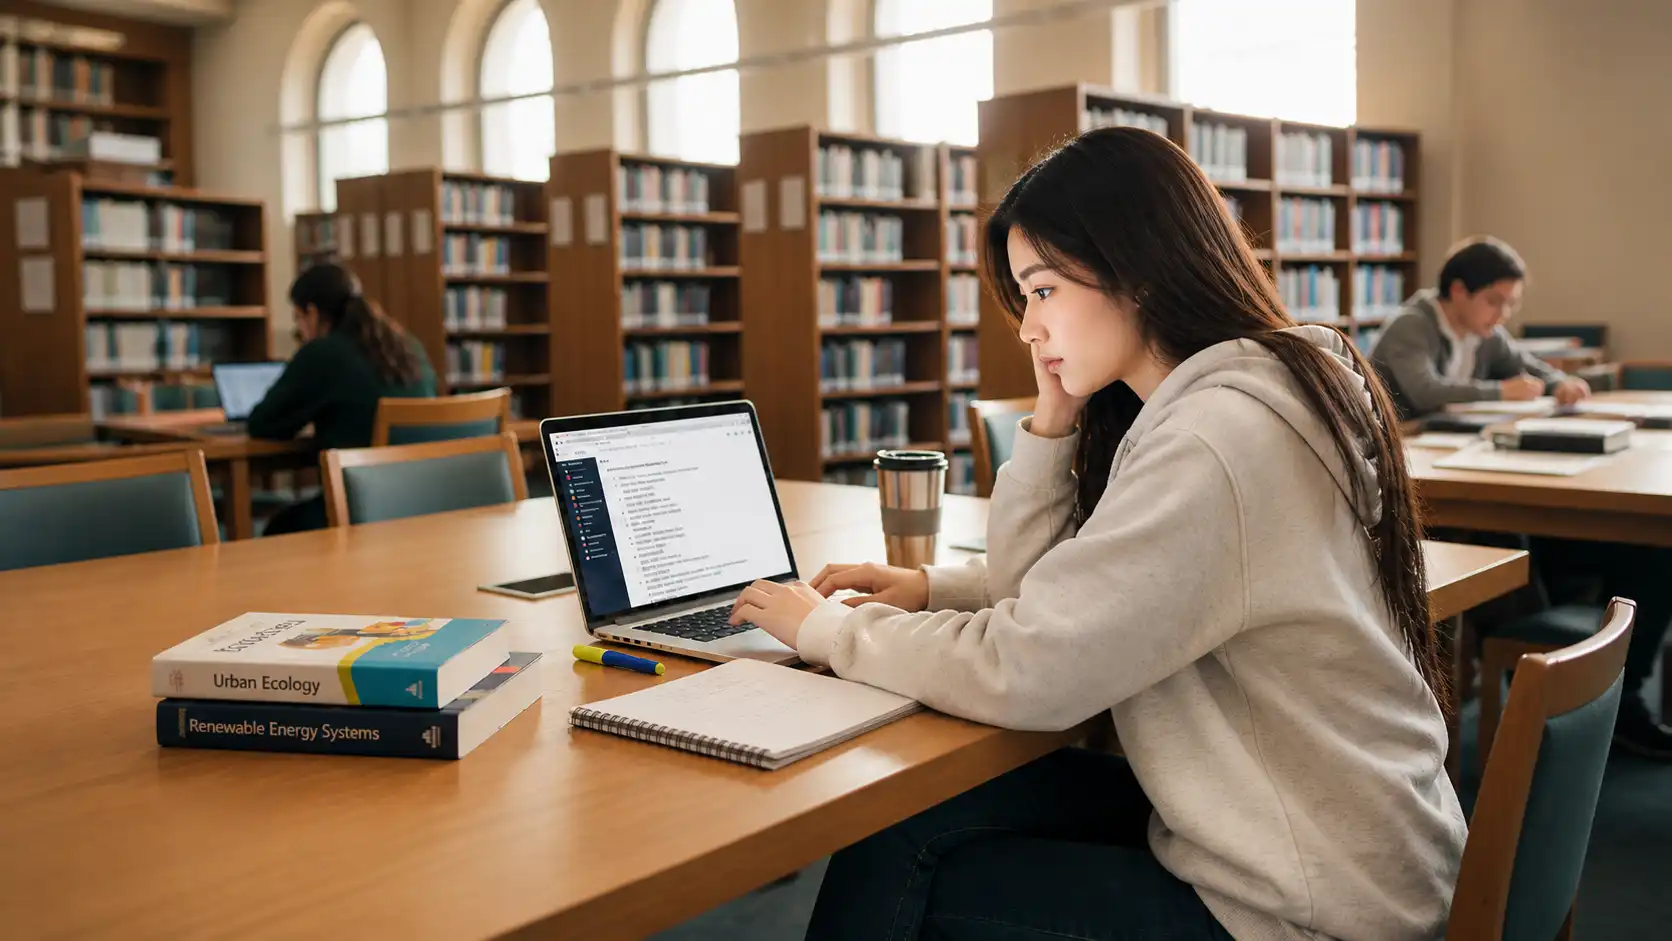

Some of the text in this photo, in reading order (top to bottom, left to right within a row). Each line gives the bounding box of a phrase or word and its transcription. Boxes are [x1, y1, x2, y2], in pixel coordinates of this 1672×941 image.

[213, 673, 320, 696] Urban Ecology
[189, 718, 265, 736] Renewable
[269, 721, 318, 741] Energy
[322, 723, 380, 742] Systems
